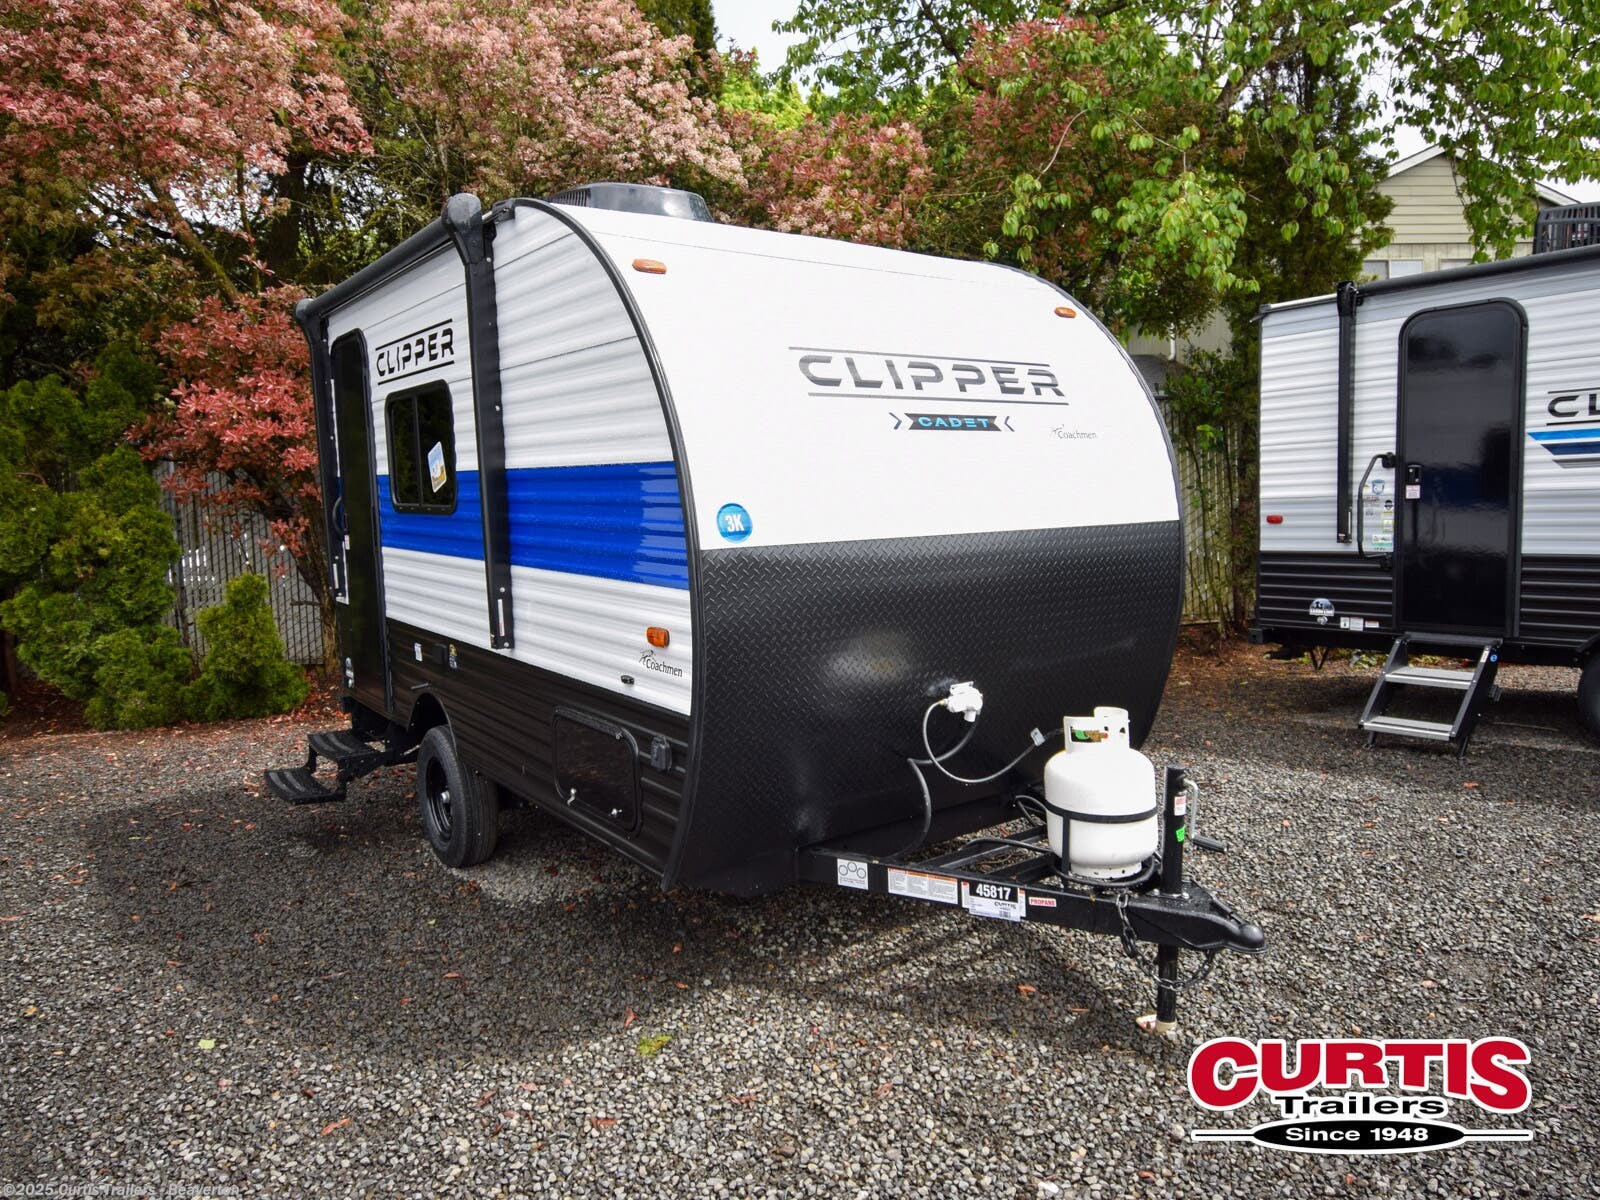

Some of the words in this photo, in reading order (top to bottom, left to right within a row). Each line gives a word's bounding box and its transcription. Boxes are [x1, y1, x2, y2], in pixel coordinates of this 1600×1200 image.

[376, 327, 454, 377] CLIPPER
[798, 354, 1065, 397] CLIPPER
[917, 416, 989, 429] CADET
[1057, 430, 1097, 440] Coachmen
[725, 513, 745, 532] 3K
[646, 658, 683, 678] Coachmen
[976, 882, 1012, 900] 45817
[1030, 897, 1055, 907] PROPANE
